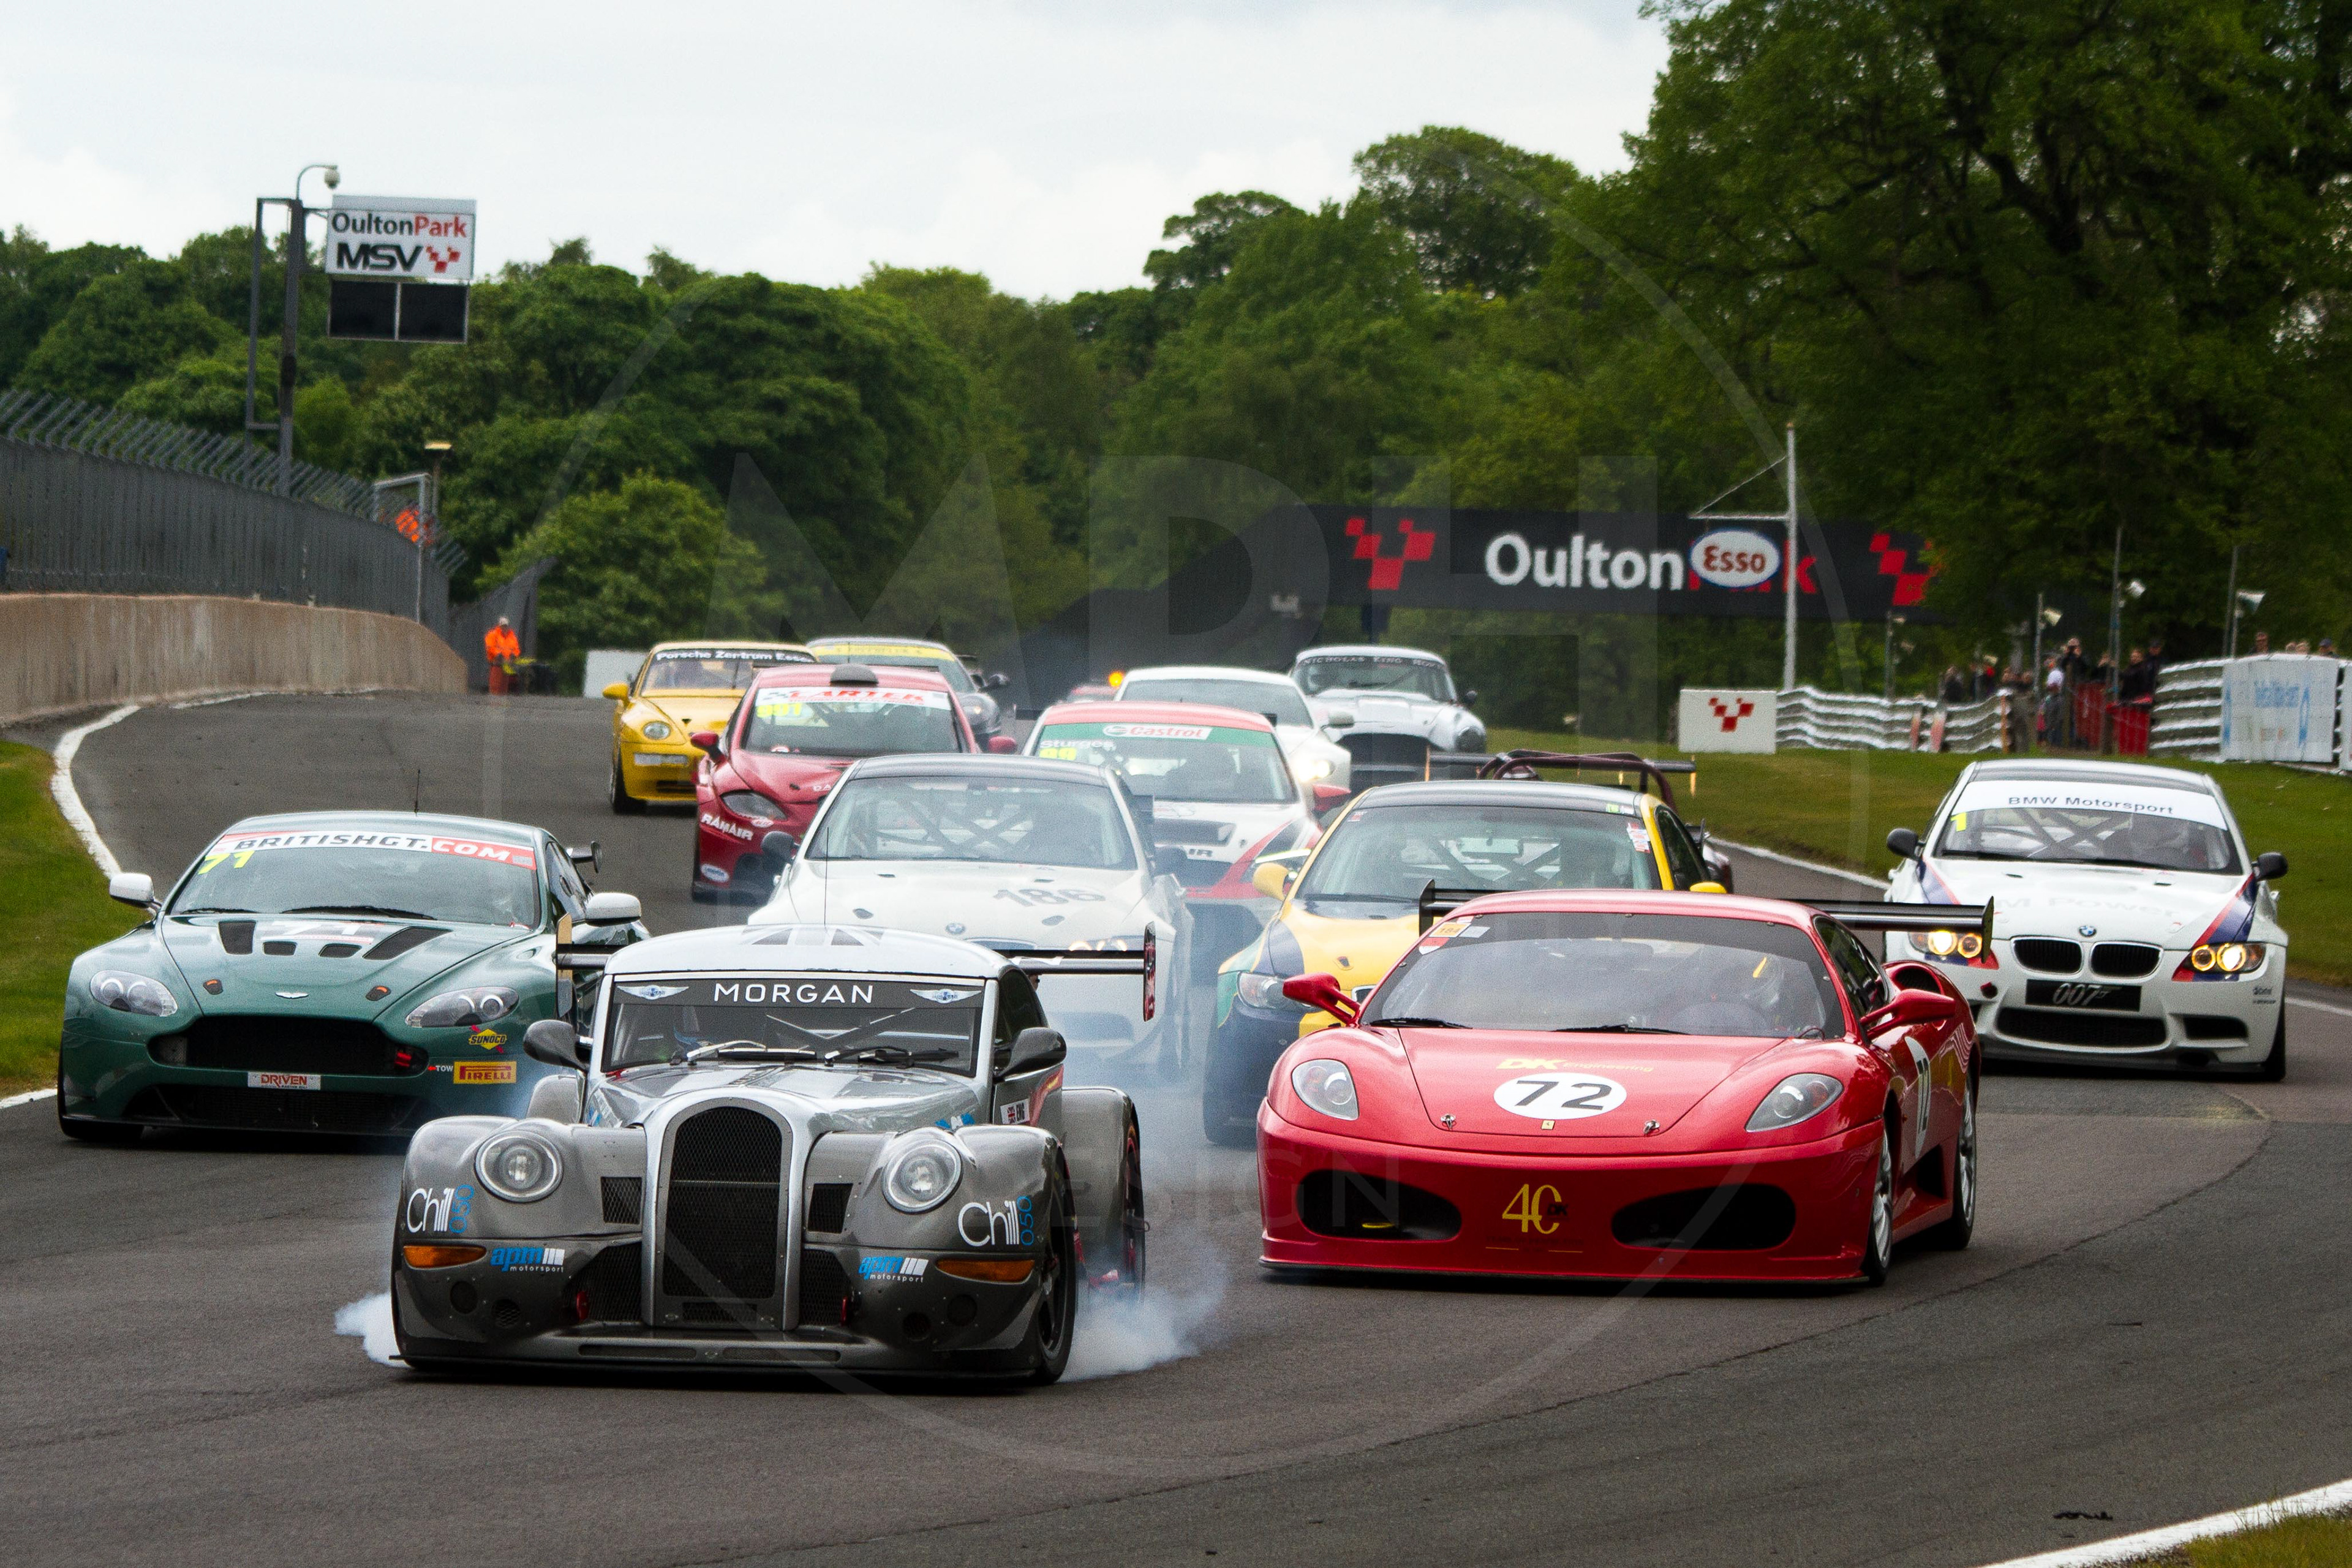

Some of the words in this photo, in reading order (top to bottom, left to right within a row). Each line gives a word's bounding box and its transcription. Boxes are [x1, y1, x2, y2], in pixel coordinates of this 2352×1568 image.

[331, 213, 467, 238] OultonPark
[336, 242, 424, 271] MSV
[1703, 539, 1766, 573] Esso
[1129, 725, 1202, 737] Castrol
[2008, 797, 2056, 805] BMW
[2065, 797, 2174, 815] Motorsport
[1950, 812, 1967, 832] 1
[234, 834, 512, 862] BRITISHGT.COM
[197, 850, 256, 875] 71
[993, 889, 1106, 907] 186
[714, 983, 873, 1003] MORGAN
[2052, 982, 2103, 1005] 007
[470, 1035, 507, 1044] SUNOCO
[260, 1074, 307, 1088] DRIVEN
[459, 1065, 511, 1080] PIRELLI
[1514, 1080, 1613, 1110] 72
[491, 1246, 544, 1272] apm
[858, 1256, 904, 1280] apm
[870, 1274, 924, 1283] motorsport
